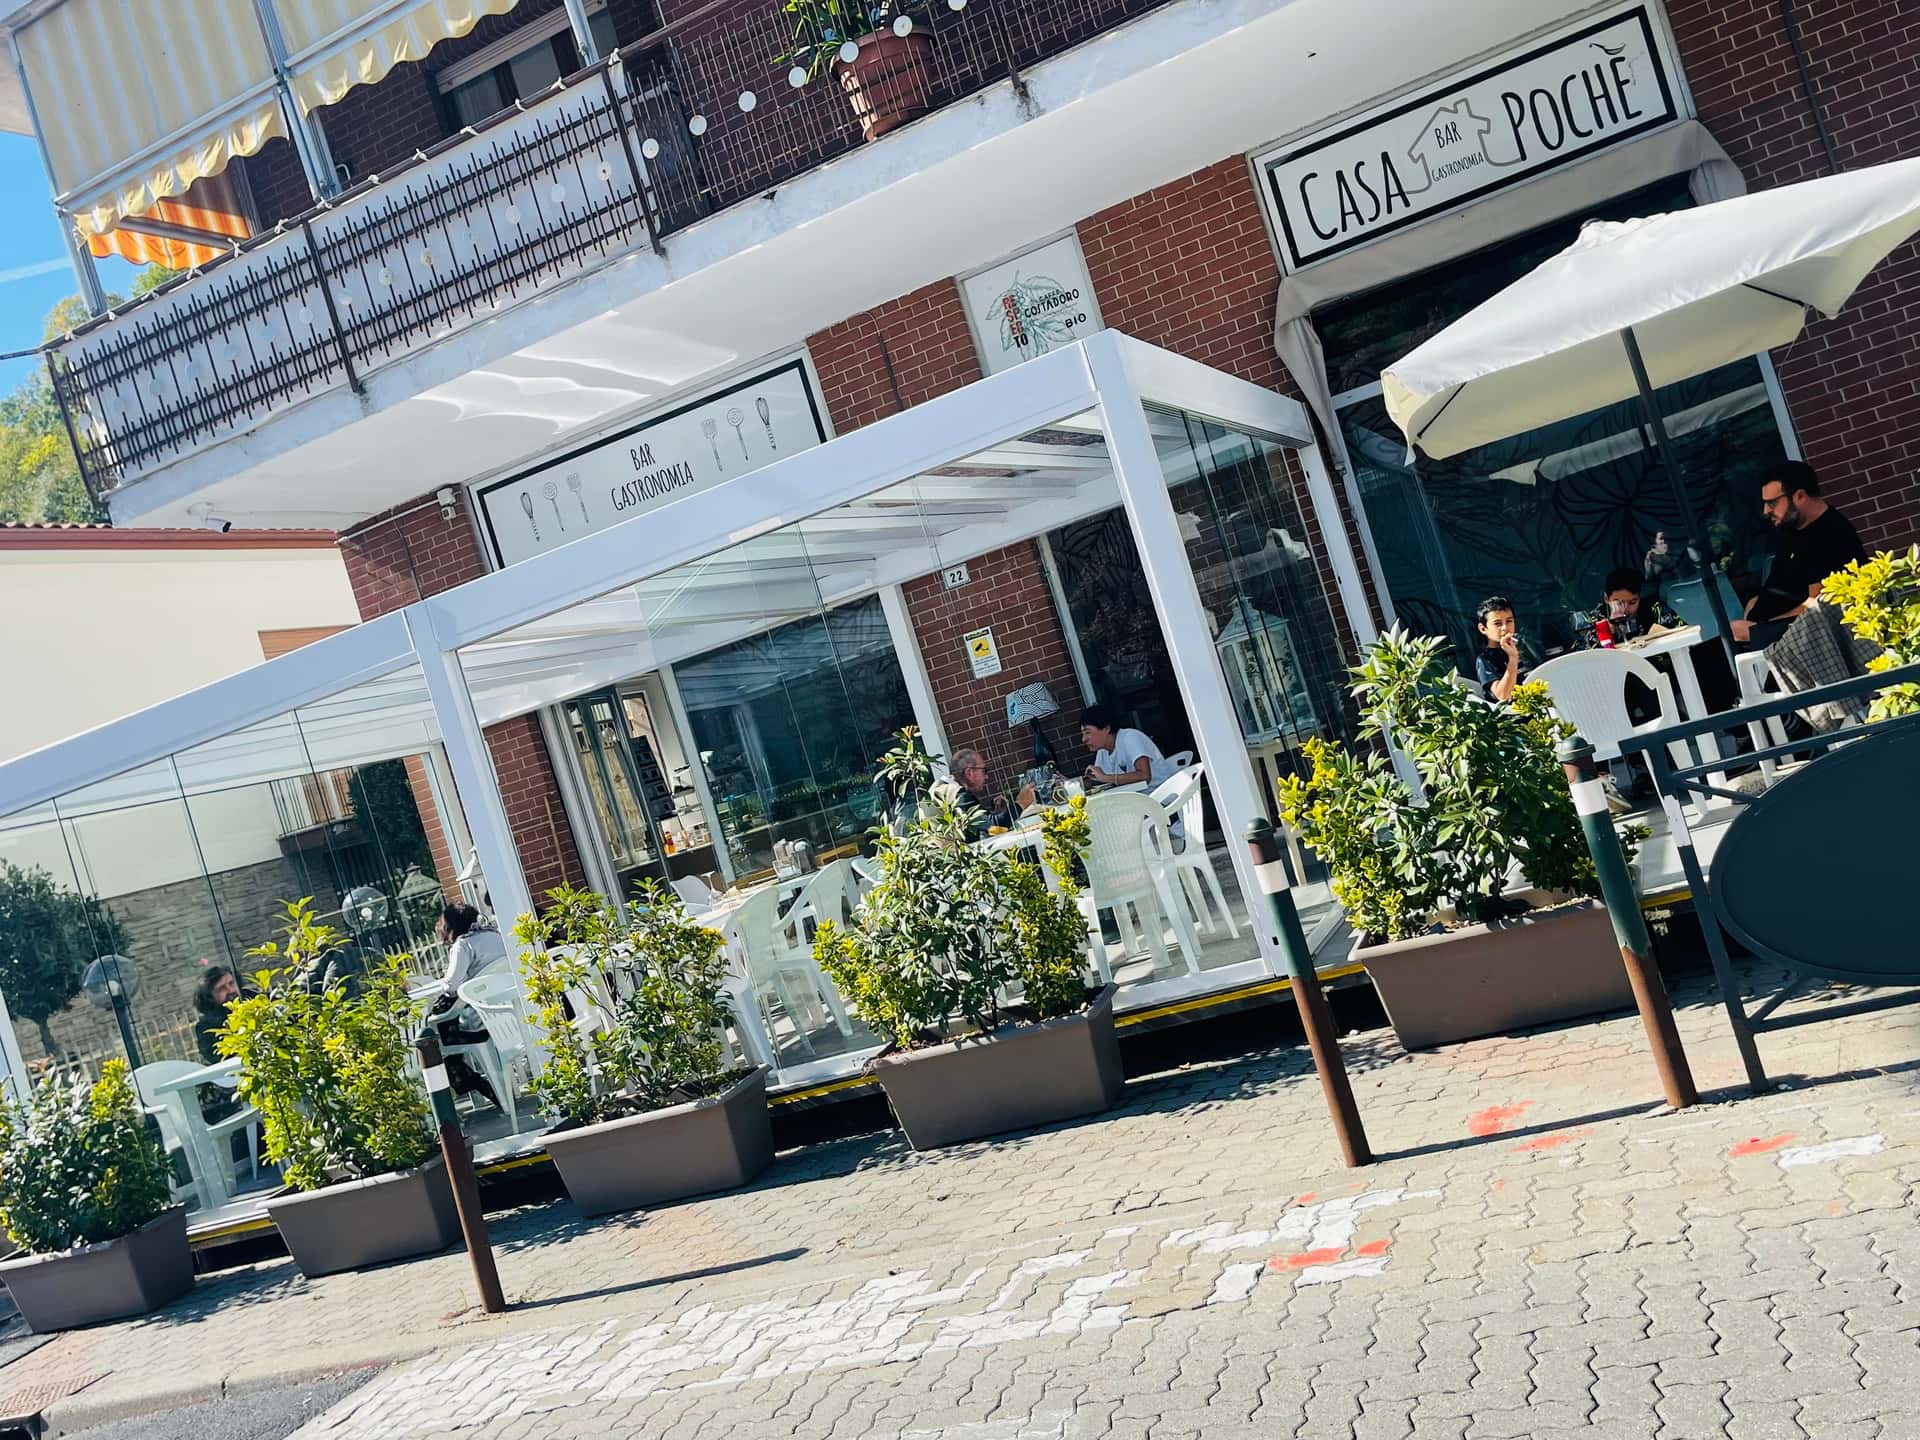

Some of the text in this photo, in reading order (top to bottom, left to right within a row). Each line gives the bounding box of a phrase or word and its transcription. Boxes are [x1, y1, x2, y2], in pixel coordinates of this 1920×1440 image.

[1434, 121, 1463, 149] BAR
[1431, 151, 1485, 182] GASTRONOMIA
[1299, 151, 1411, 241] CASA
[1024, 288, 1080, 318] COSTADORO
[1065, 313, 1087, 328] BIO
[630, 443, 656, 471] BAR
[611, 460, 695, 511] GASTRONOMIA
[950, 570, 963, 583] 22
